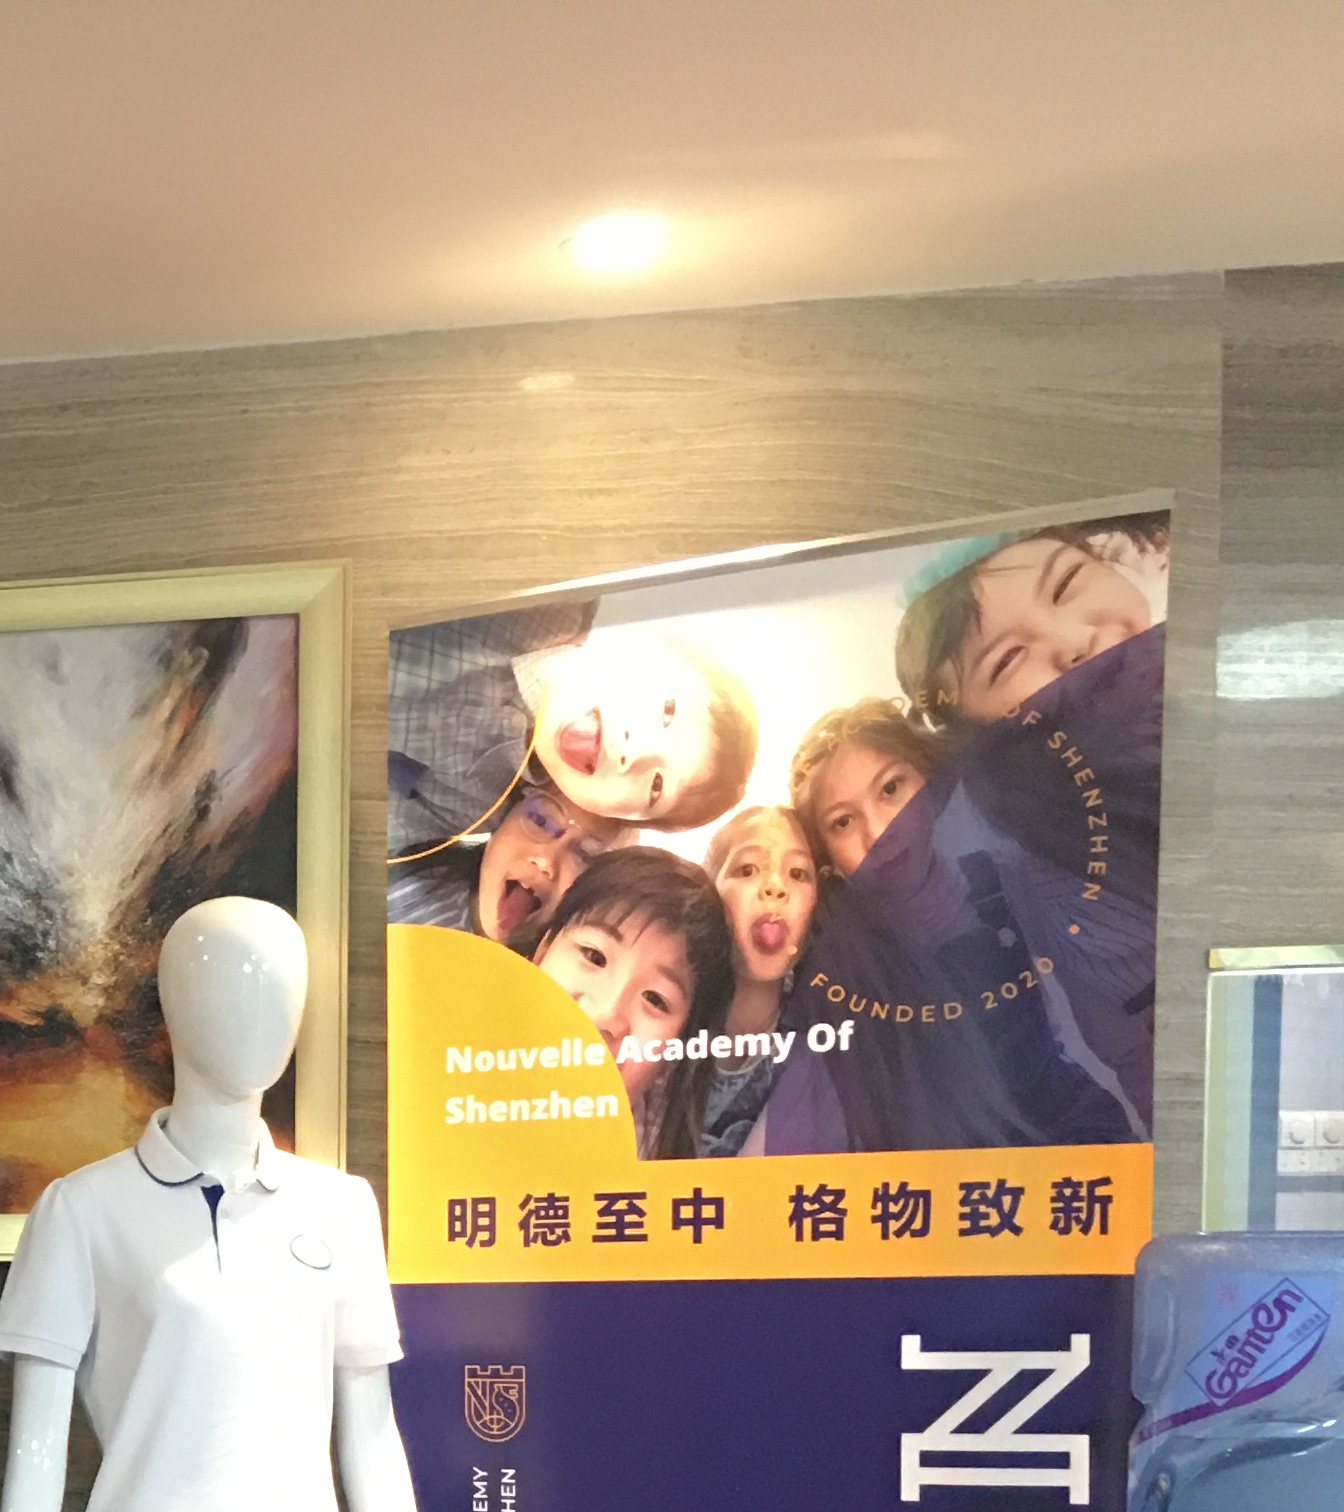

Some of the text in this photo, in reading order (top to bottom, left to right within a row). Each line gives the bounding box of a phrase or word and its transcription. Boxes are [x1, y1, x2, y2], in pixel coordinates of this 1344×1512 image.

[1047, 731, 1110, 901] SHENZHEN
[810, 957, 1054, 1023] FOUNDED 2020
[445, 1020, 855, 1074] Nouvelle Academy Of
[445, 1091, 619, 1125] Shenzhen
[446, 1176, 1115, 1249] 明德至中 格物致新
